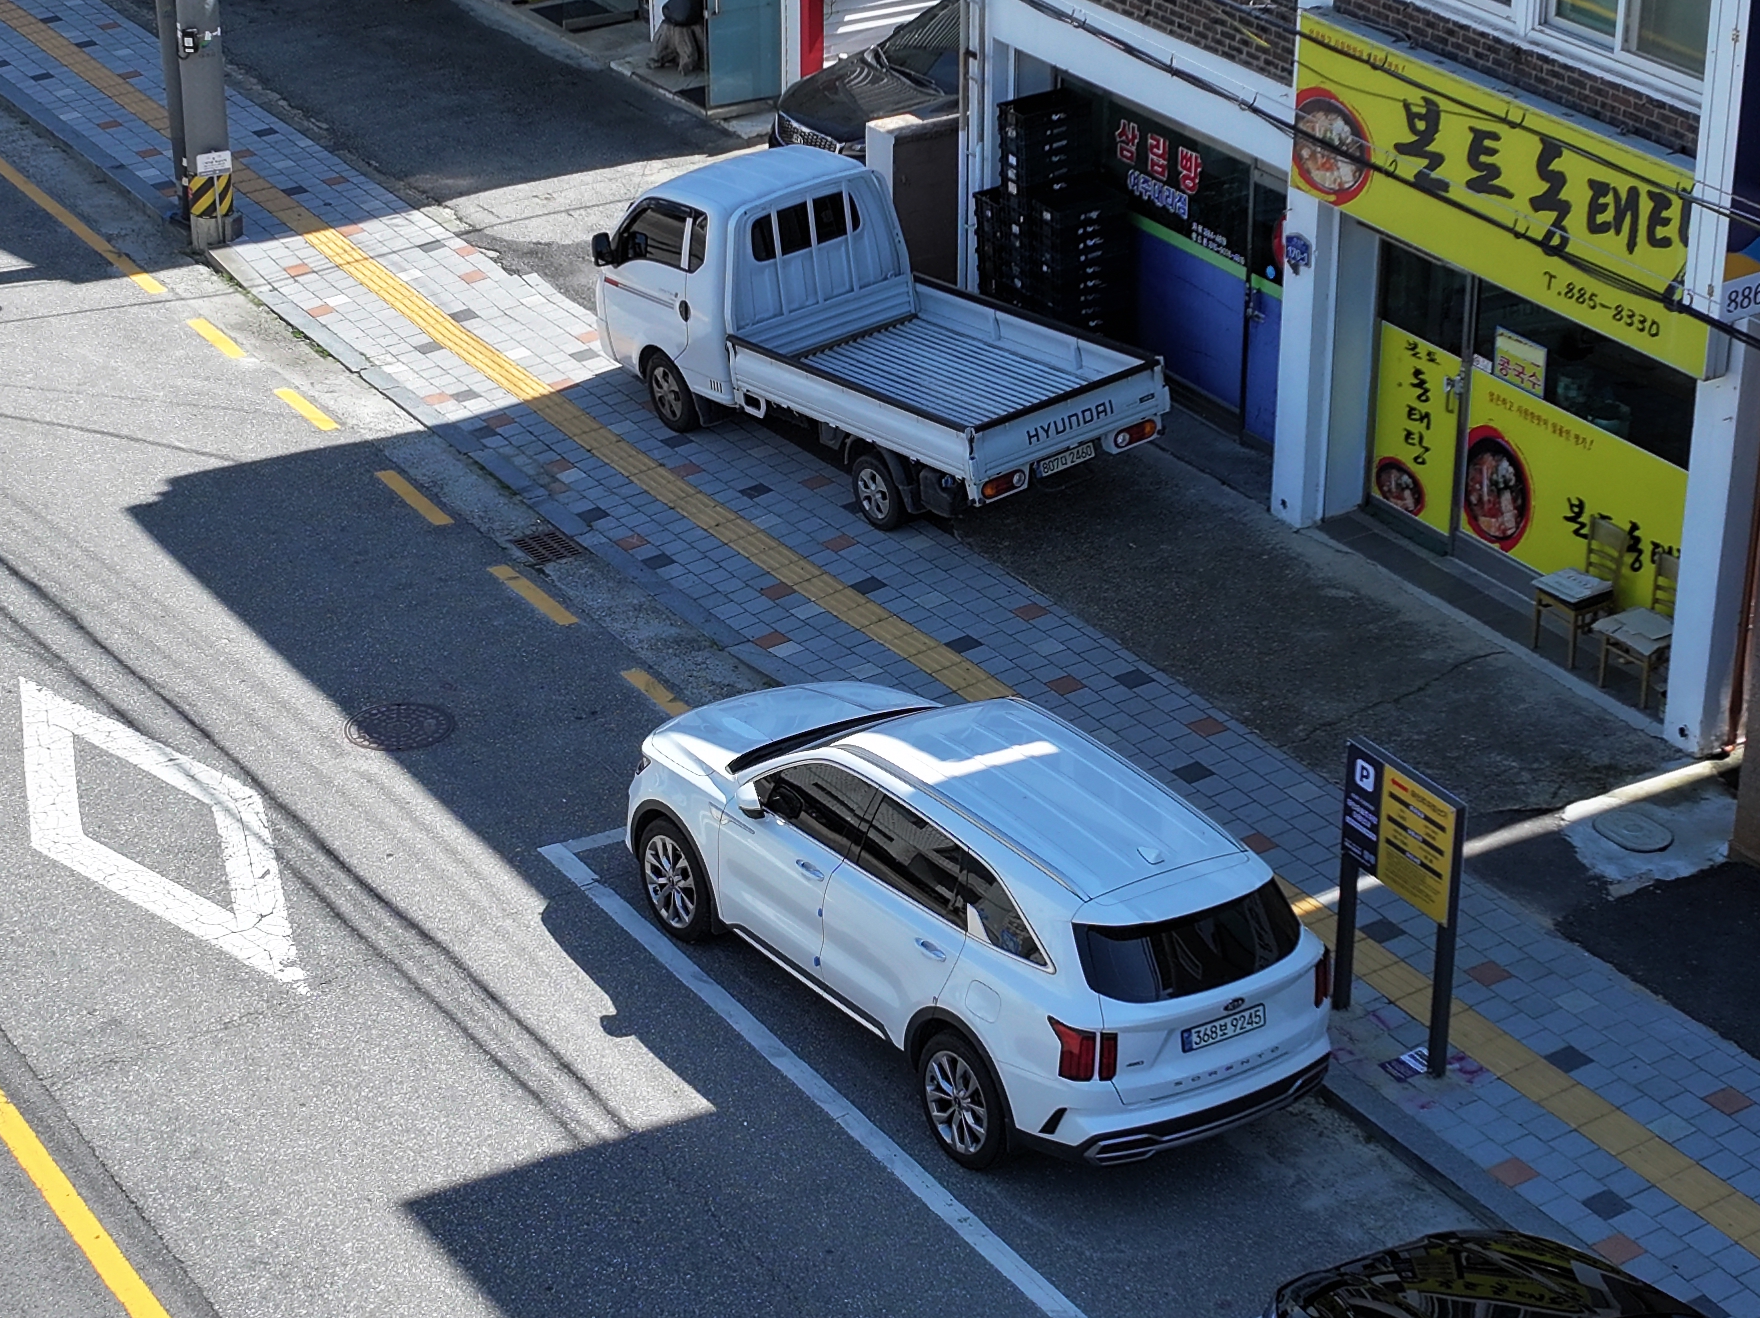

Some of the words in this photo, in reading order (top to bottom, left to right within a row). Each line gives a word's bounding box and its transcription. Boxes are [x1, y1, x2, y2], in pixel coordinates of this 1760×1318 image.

[1543, 271, 1661, 340] T.885-8330
[1404, 339, 1440, 366] 본토
[1497, 355, 1542, 390] 콩국수
[1026, 399, 1115, 446] HYUNDAI
[1403, 365, 1432, 466] 동태탕
[1069, 444, 1094, 464] 2460
[1193, 1020, 1229, 1048] 368보
[1230, 1008, 1264, 1035] 9245
